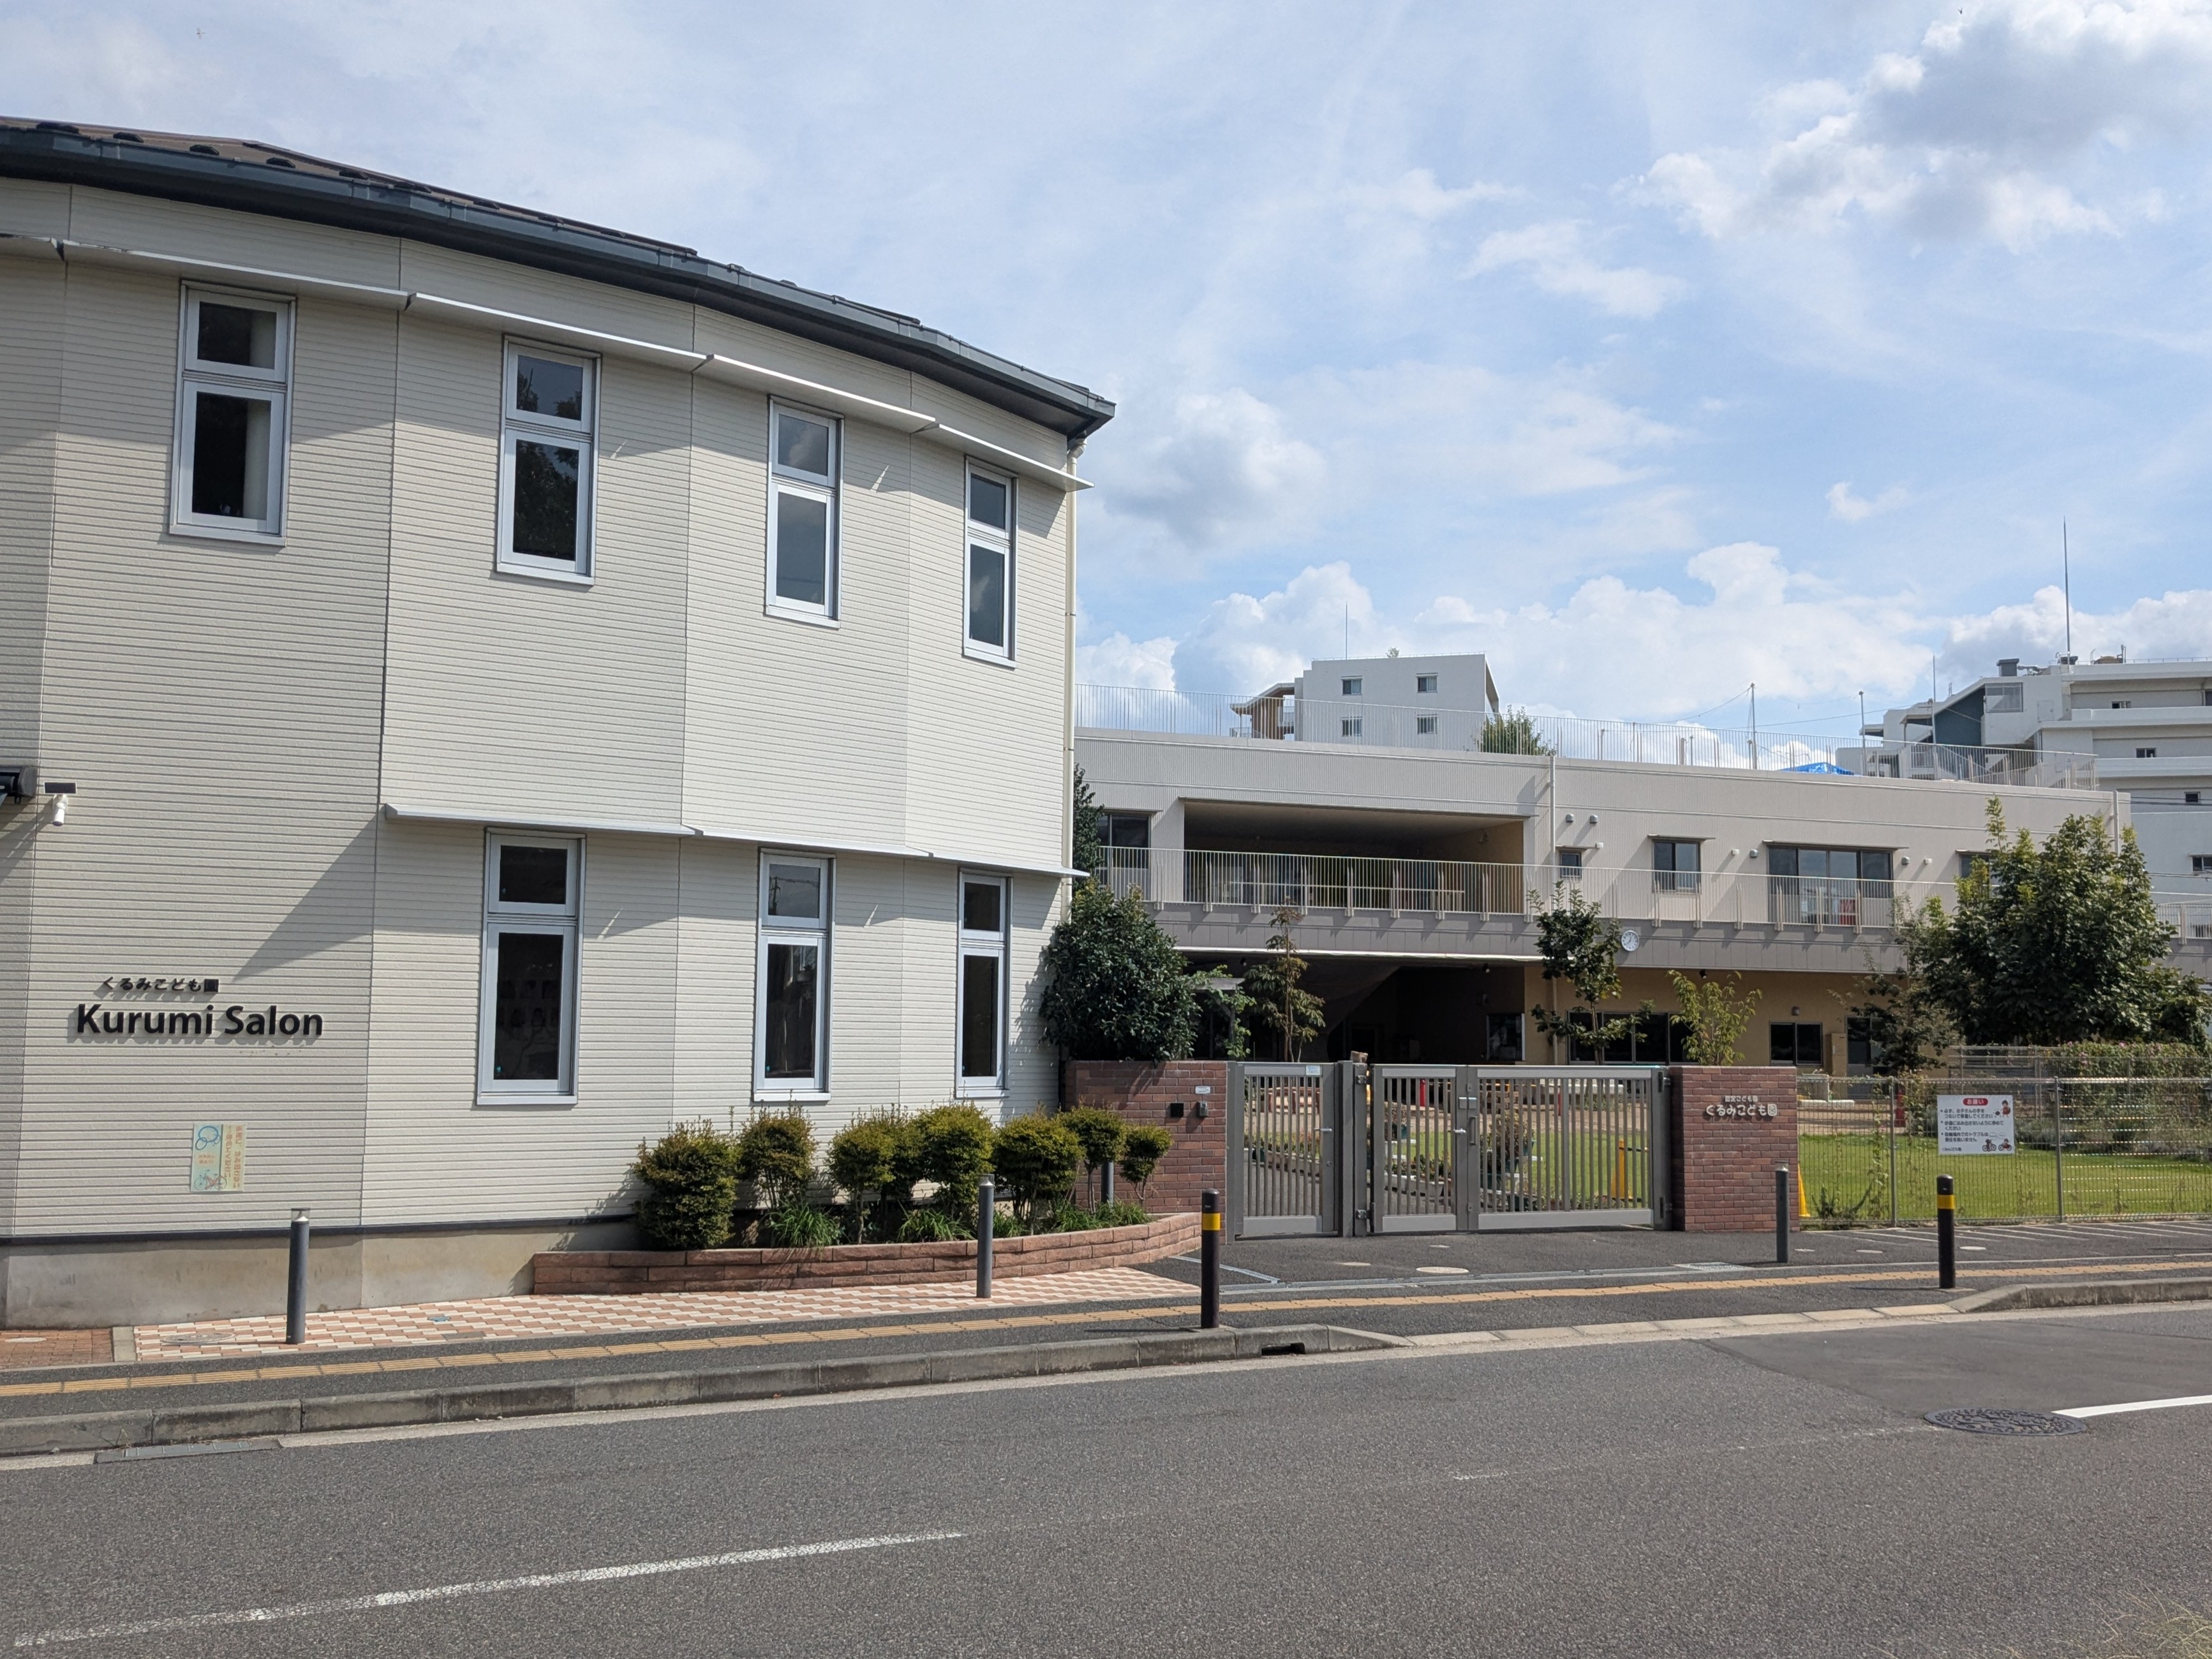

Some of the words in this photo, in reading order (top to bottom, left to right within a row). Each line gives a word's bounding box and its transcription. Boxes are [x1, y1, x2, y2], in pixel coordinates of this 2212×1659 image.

[77, 1004, 214, 1035] Kurumi
[225, 1005, 322, 1036] Salon
[1706, 1103, 1778, 1117] くるみこども園
